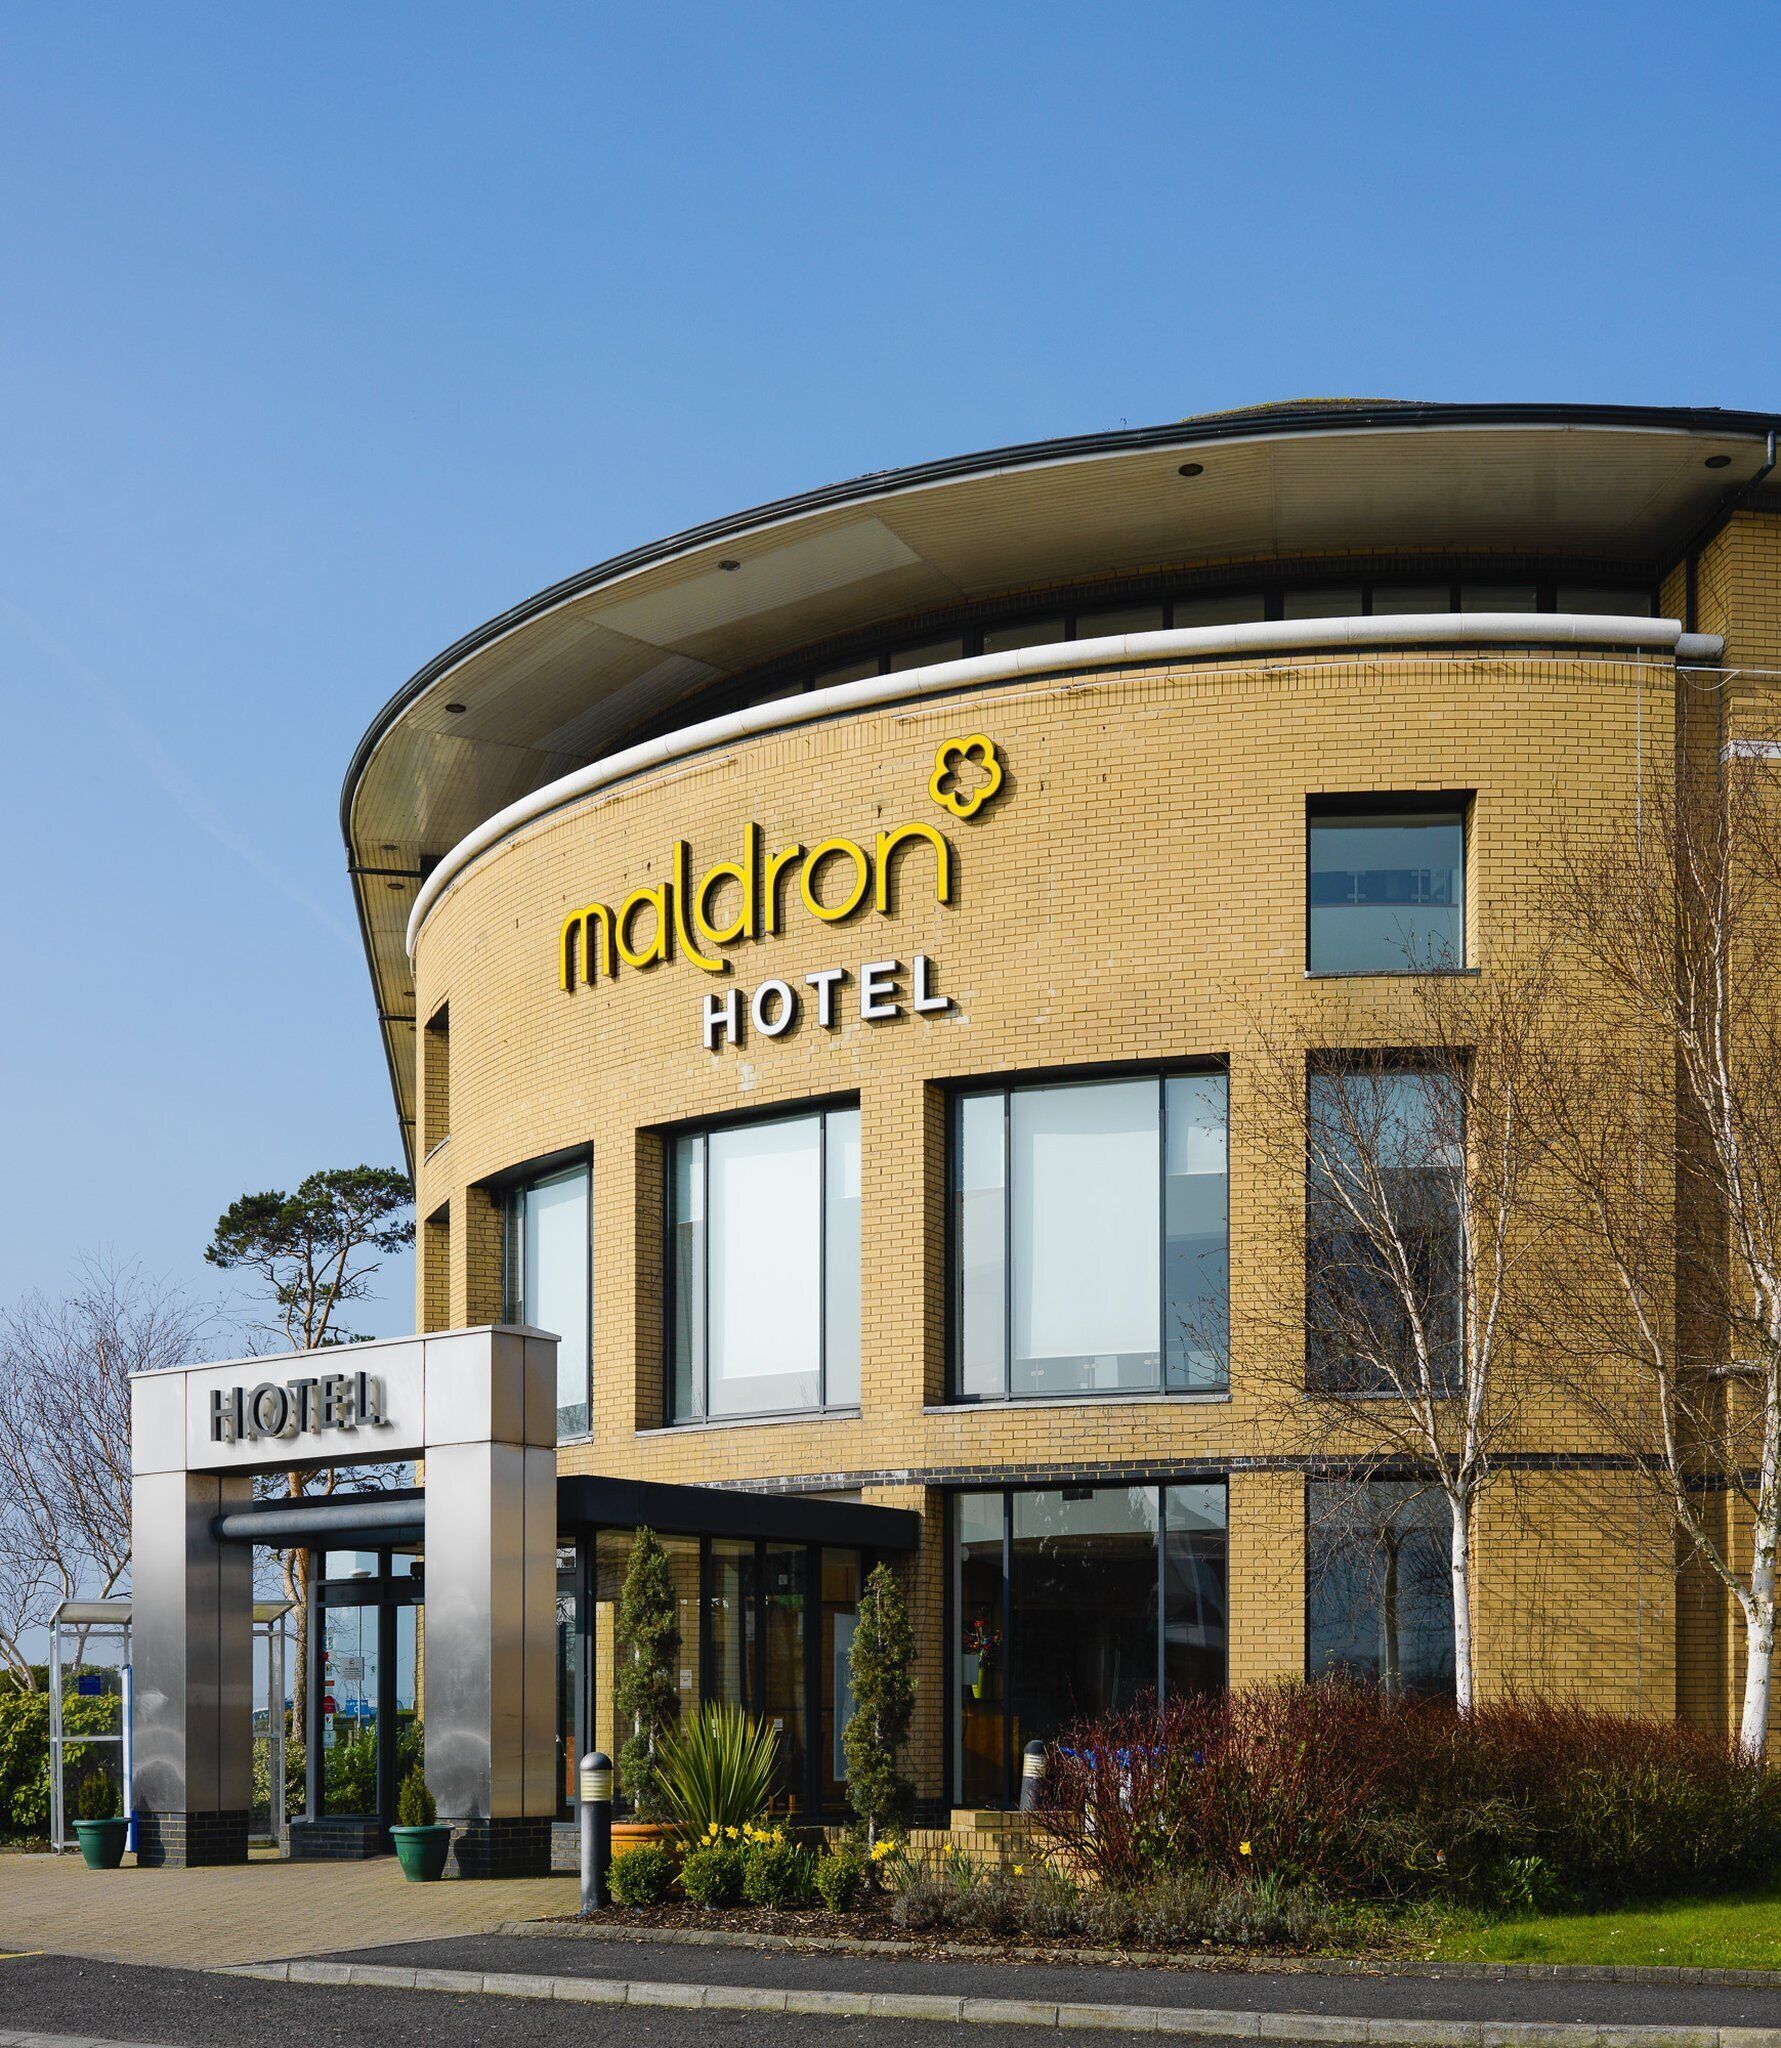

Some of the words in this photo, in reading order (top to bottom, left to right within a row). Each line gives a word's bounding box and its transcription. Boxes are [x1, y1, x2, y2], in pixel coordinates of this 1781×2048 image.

[559, 822, 952, 992] maldron
[703, 954, 953, 1051] HOTEL
[210, 1371, 384, 1443] HOTEL
